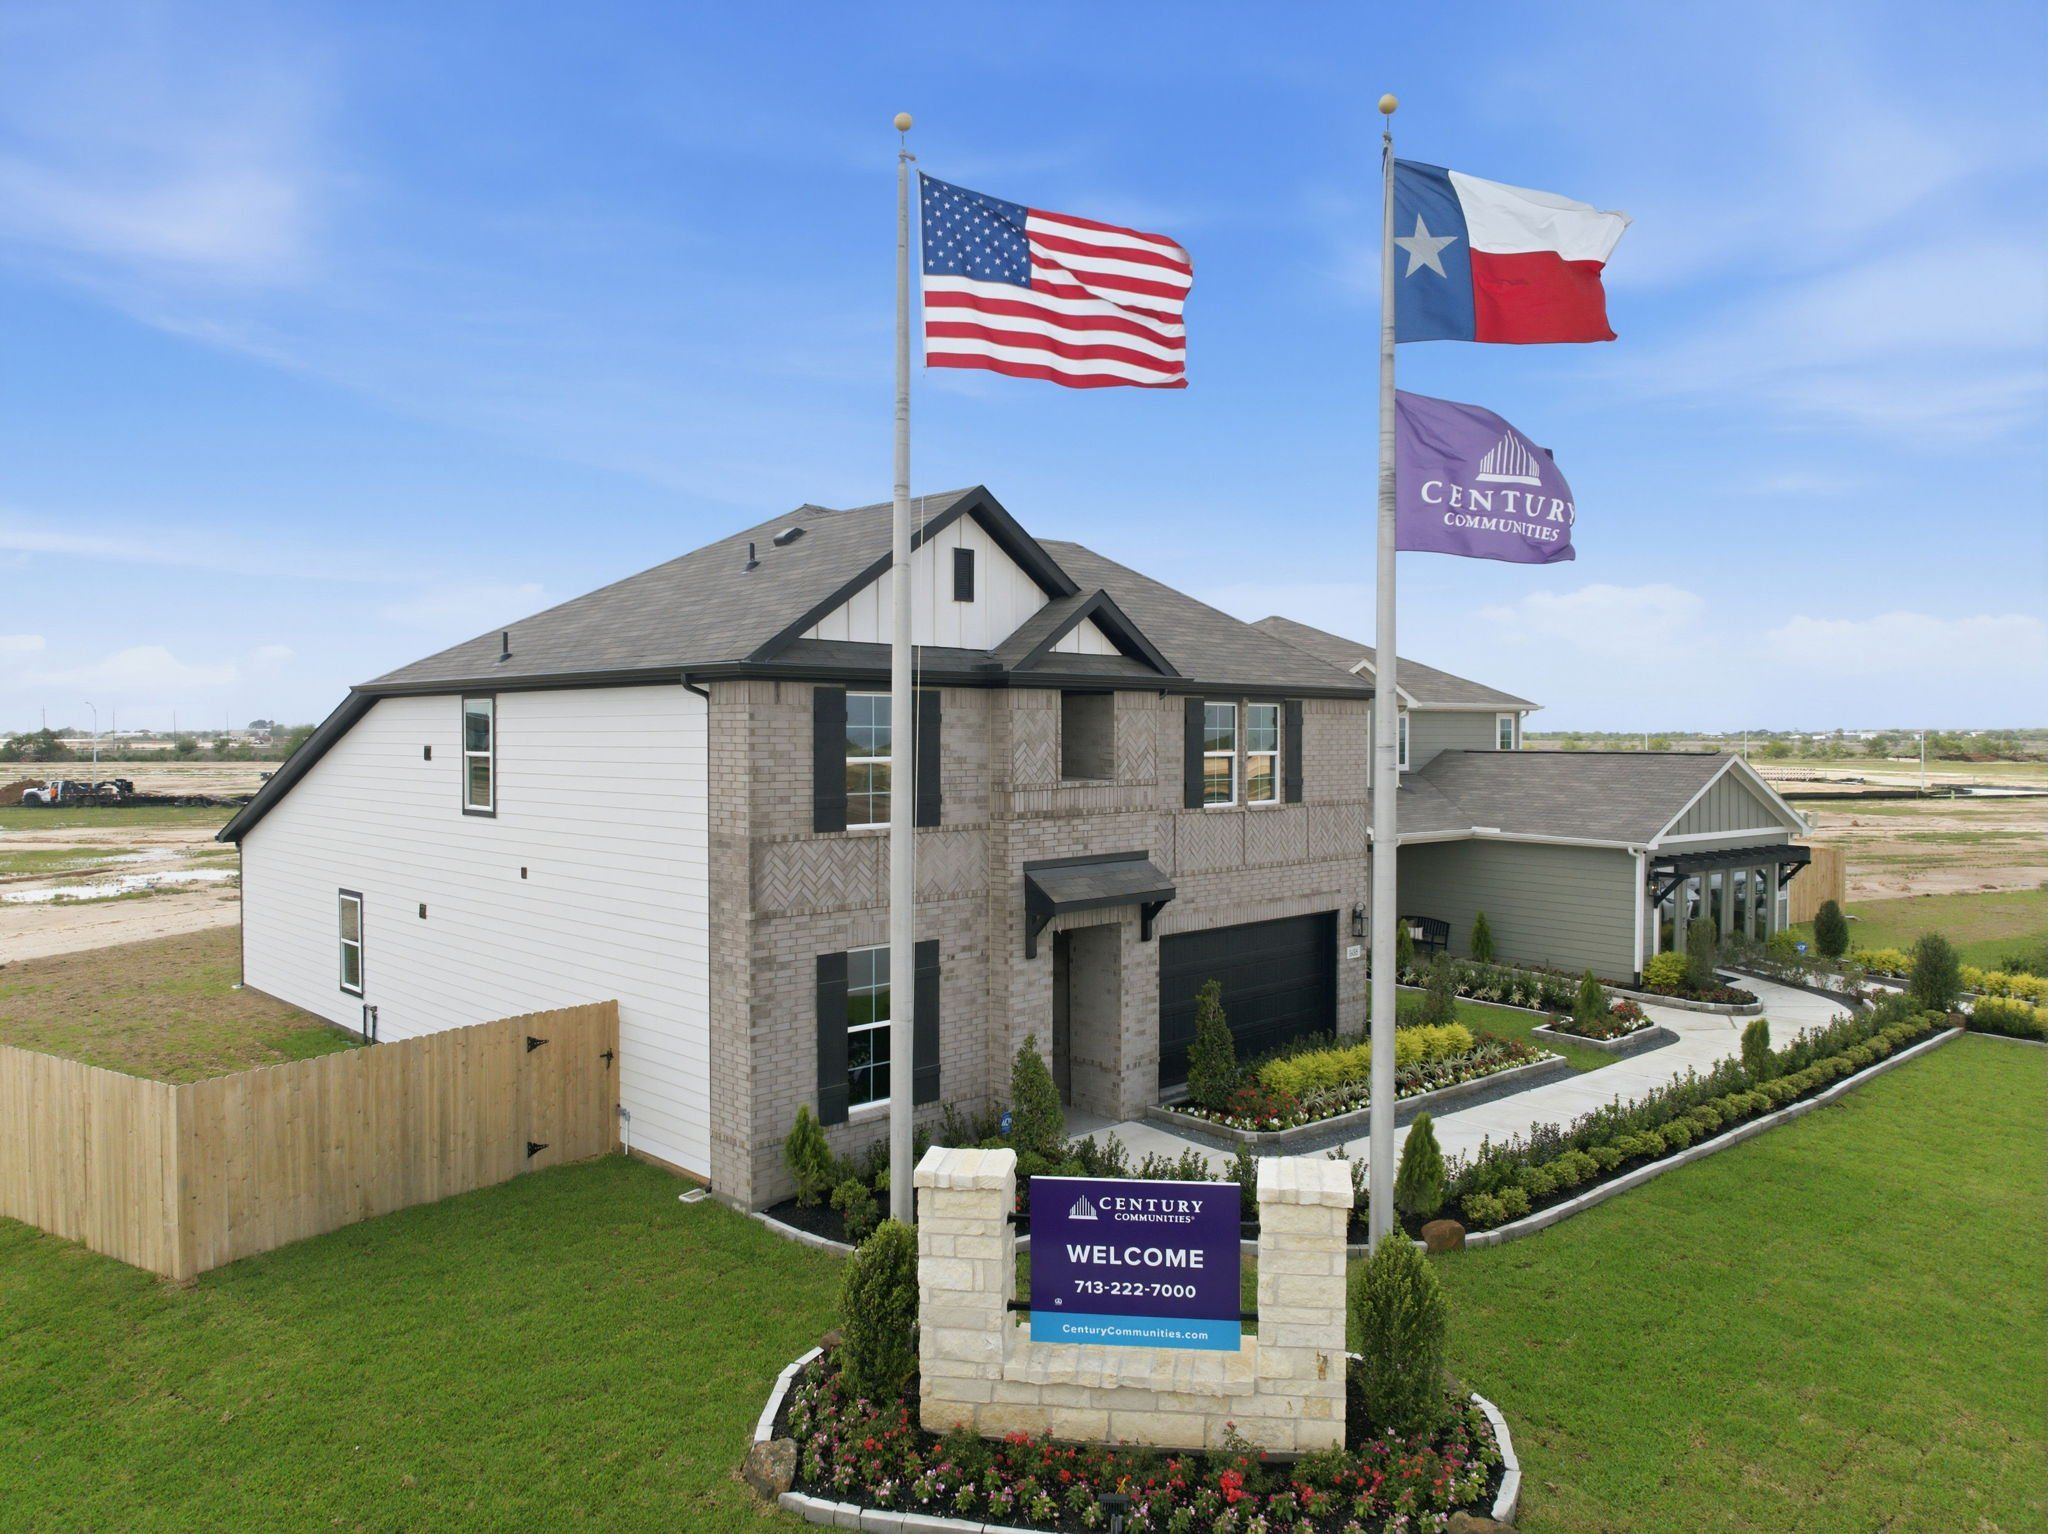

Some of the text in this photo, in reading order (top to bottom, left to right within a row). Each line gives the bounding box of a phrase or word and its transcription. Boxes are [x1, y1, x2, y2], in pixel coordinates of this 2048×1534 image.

[1443, 512, 1560, 542] COMMUNITIES
[1099, 1196, 1204, 1214] CENTURY
[1066, 1244, 1204, 1269] WELCOME
[1074, 1280, 1196, 1298] 713-222-7000
[1062, 1323, 1208, 1340] CenturyCommunities.com
